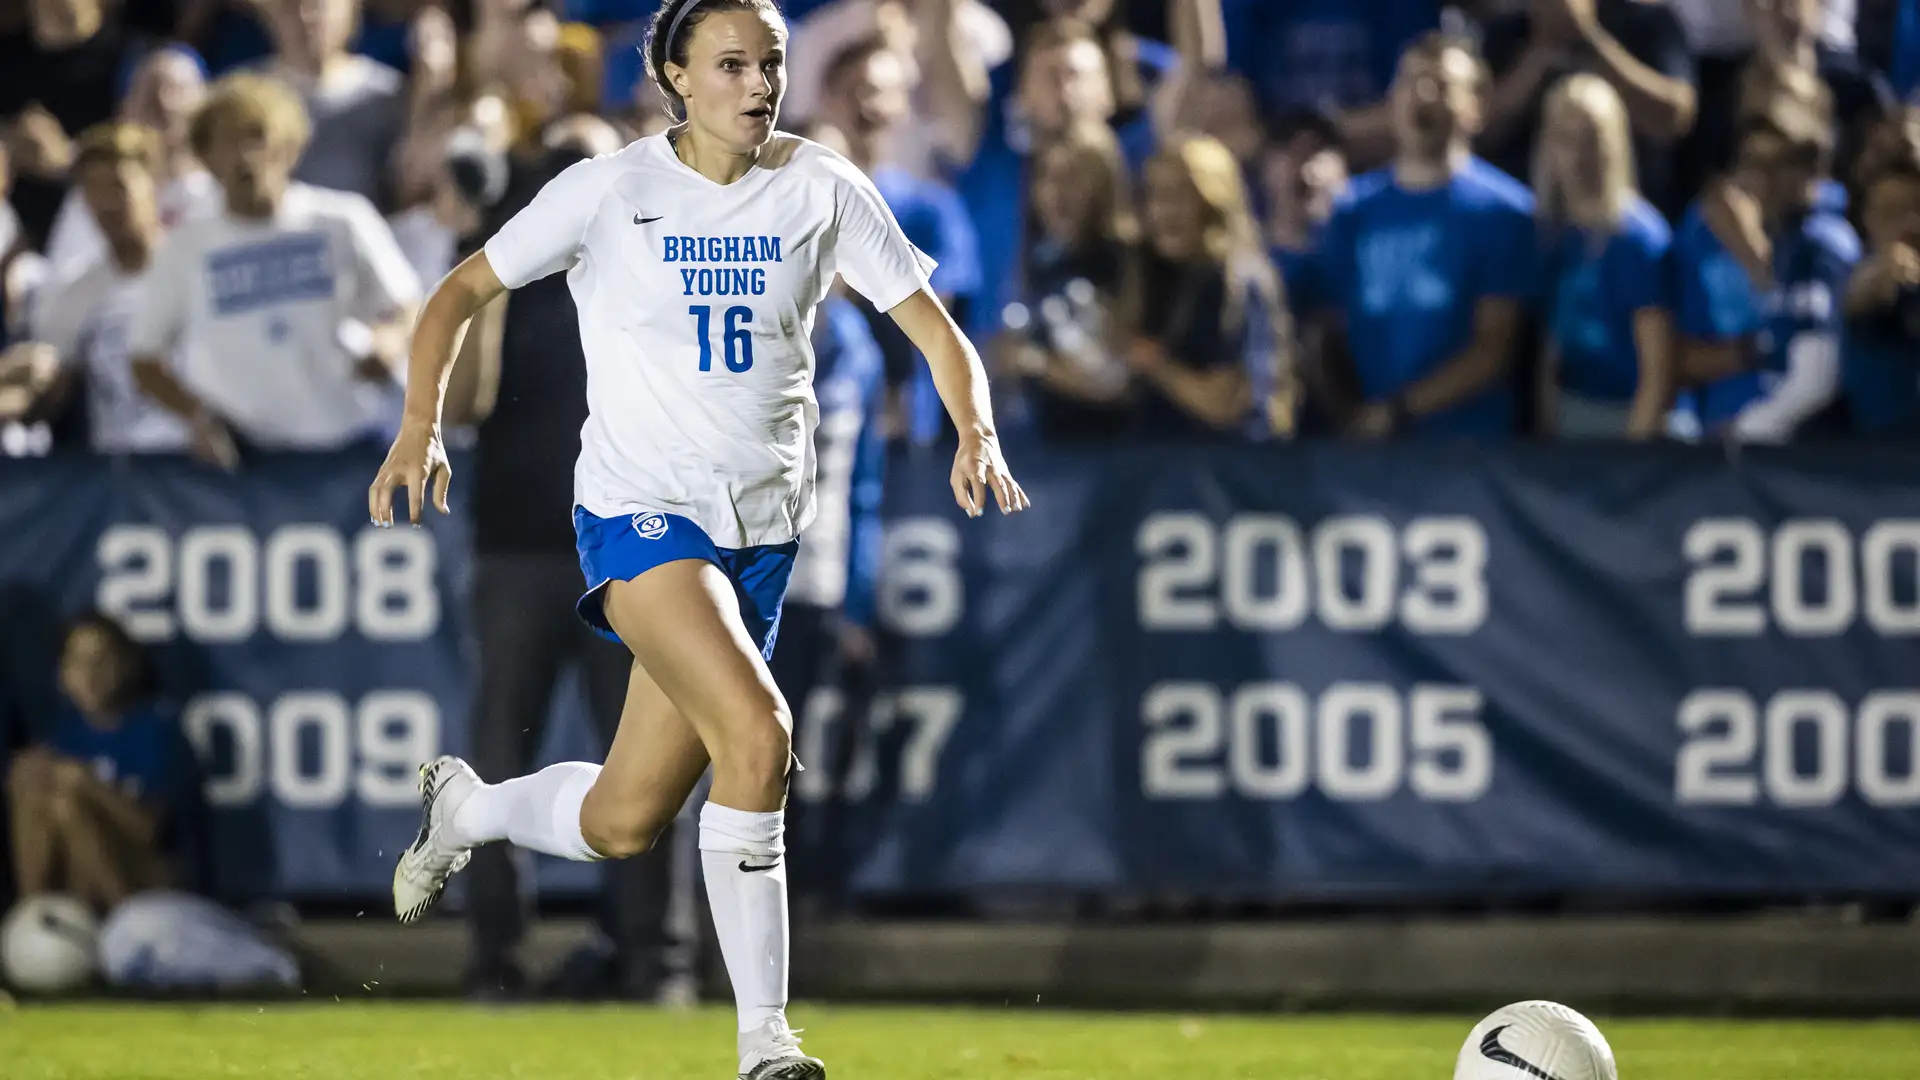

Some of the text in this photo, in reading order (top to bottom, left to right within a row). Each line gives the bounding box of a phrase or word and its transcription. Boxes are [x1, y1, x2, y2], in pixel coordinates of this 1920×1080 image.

[663, 236, 782, 262] BRIGHAM
[680, 268, 766, 296] YOUNG
[689, 305, 753, 373] 16
[97, 524, 440, 641] 2008
[1137, 514, 1488, 634] 2003
[1683, 518, 1920, 636] 200
[181, 690, 440, 807] 009
[1143, 682, 1492, 800] 2005
[1675, 689, 1920, 806] 200
